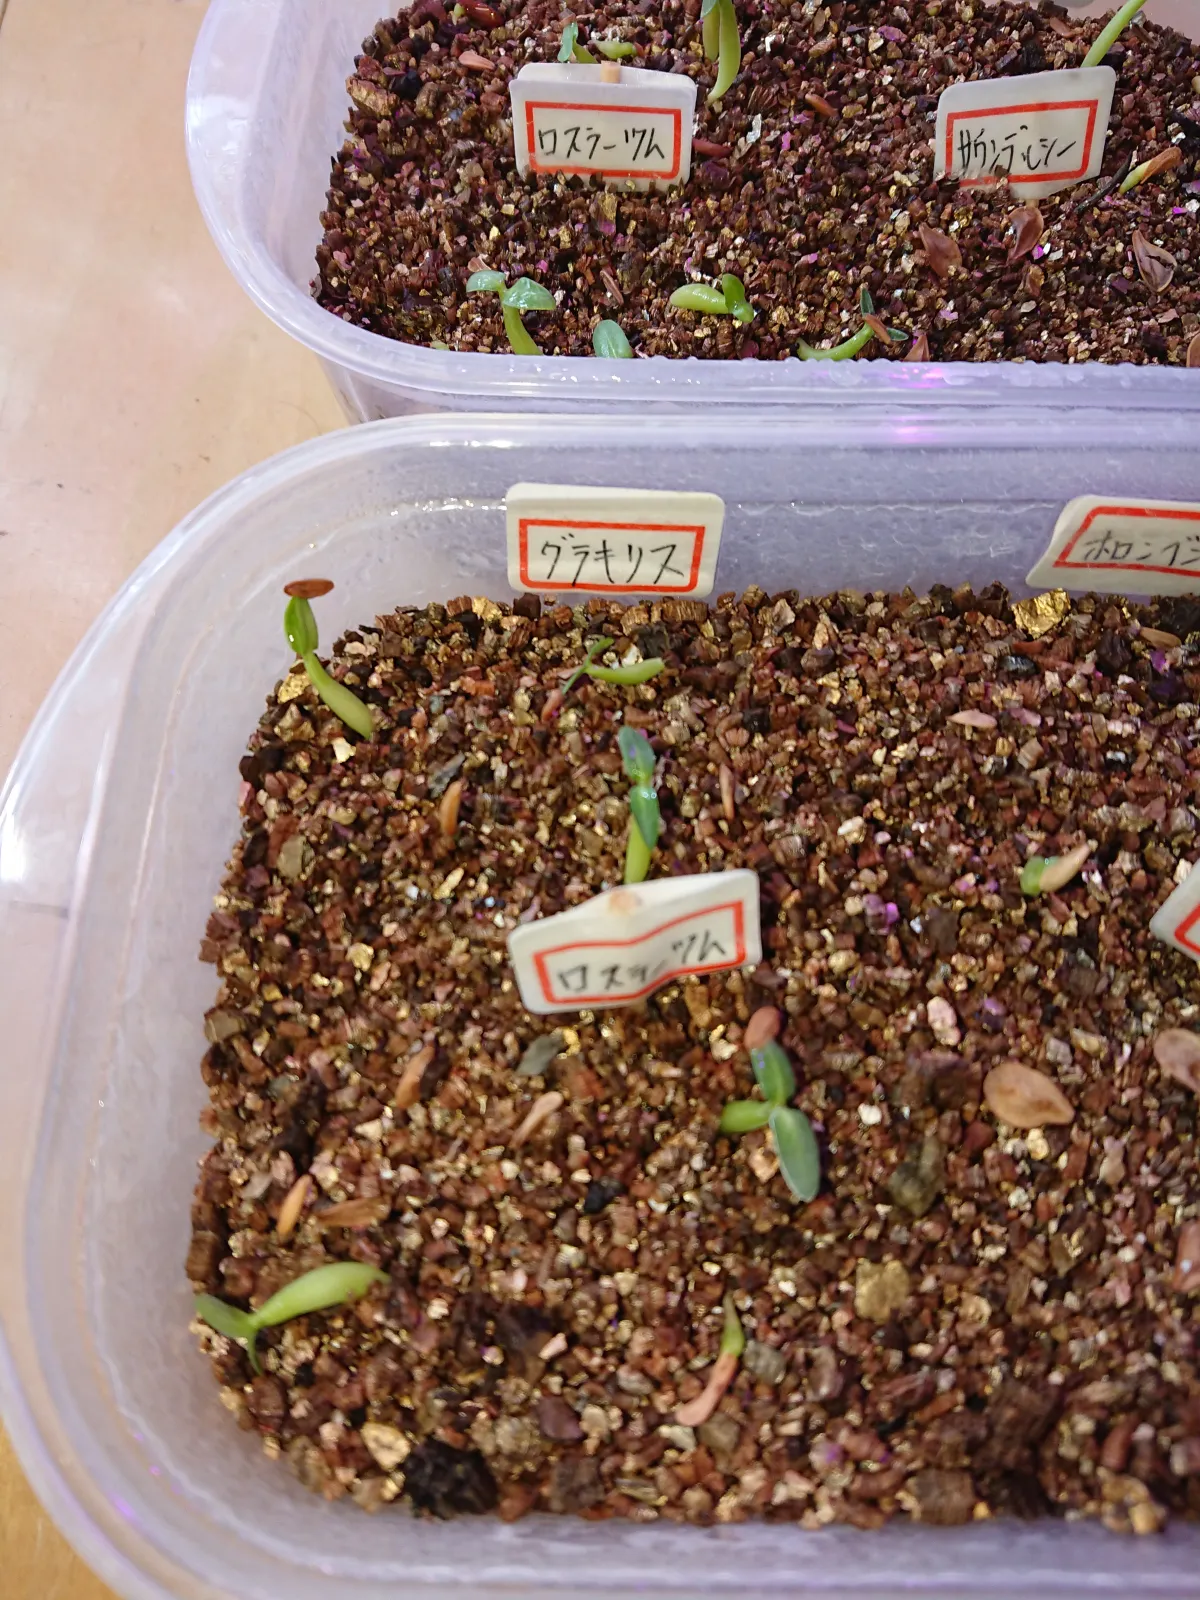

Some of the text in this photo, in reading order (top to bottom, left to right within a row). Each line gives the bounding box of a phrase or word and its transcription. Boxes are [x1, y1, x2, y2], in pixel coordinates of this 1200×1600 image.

[541, 533, 685, 587] グラキリス
